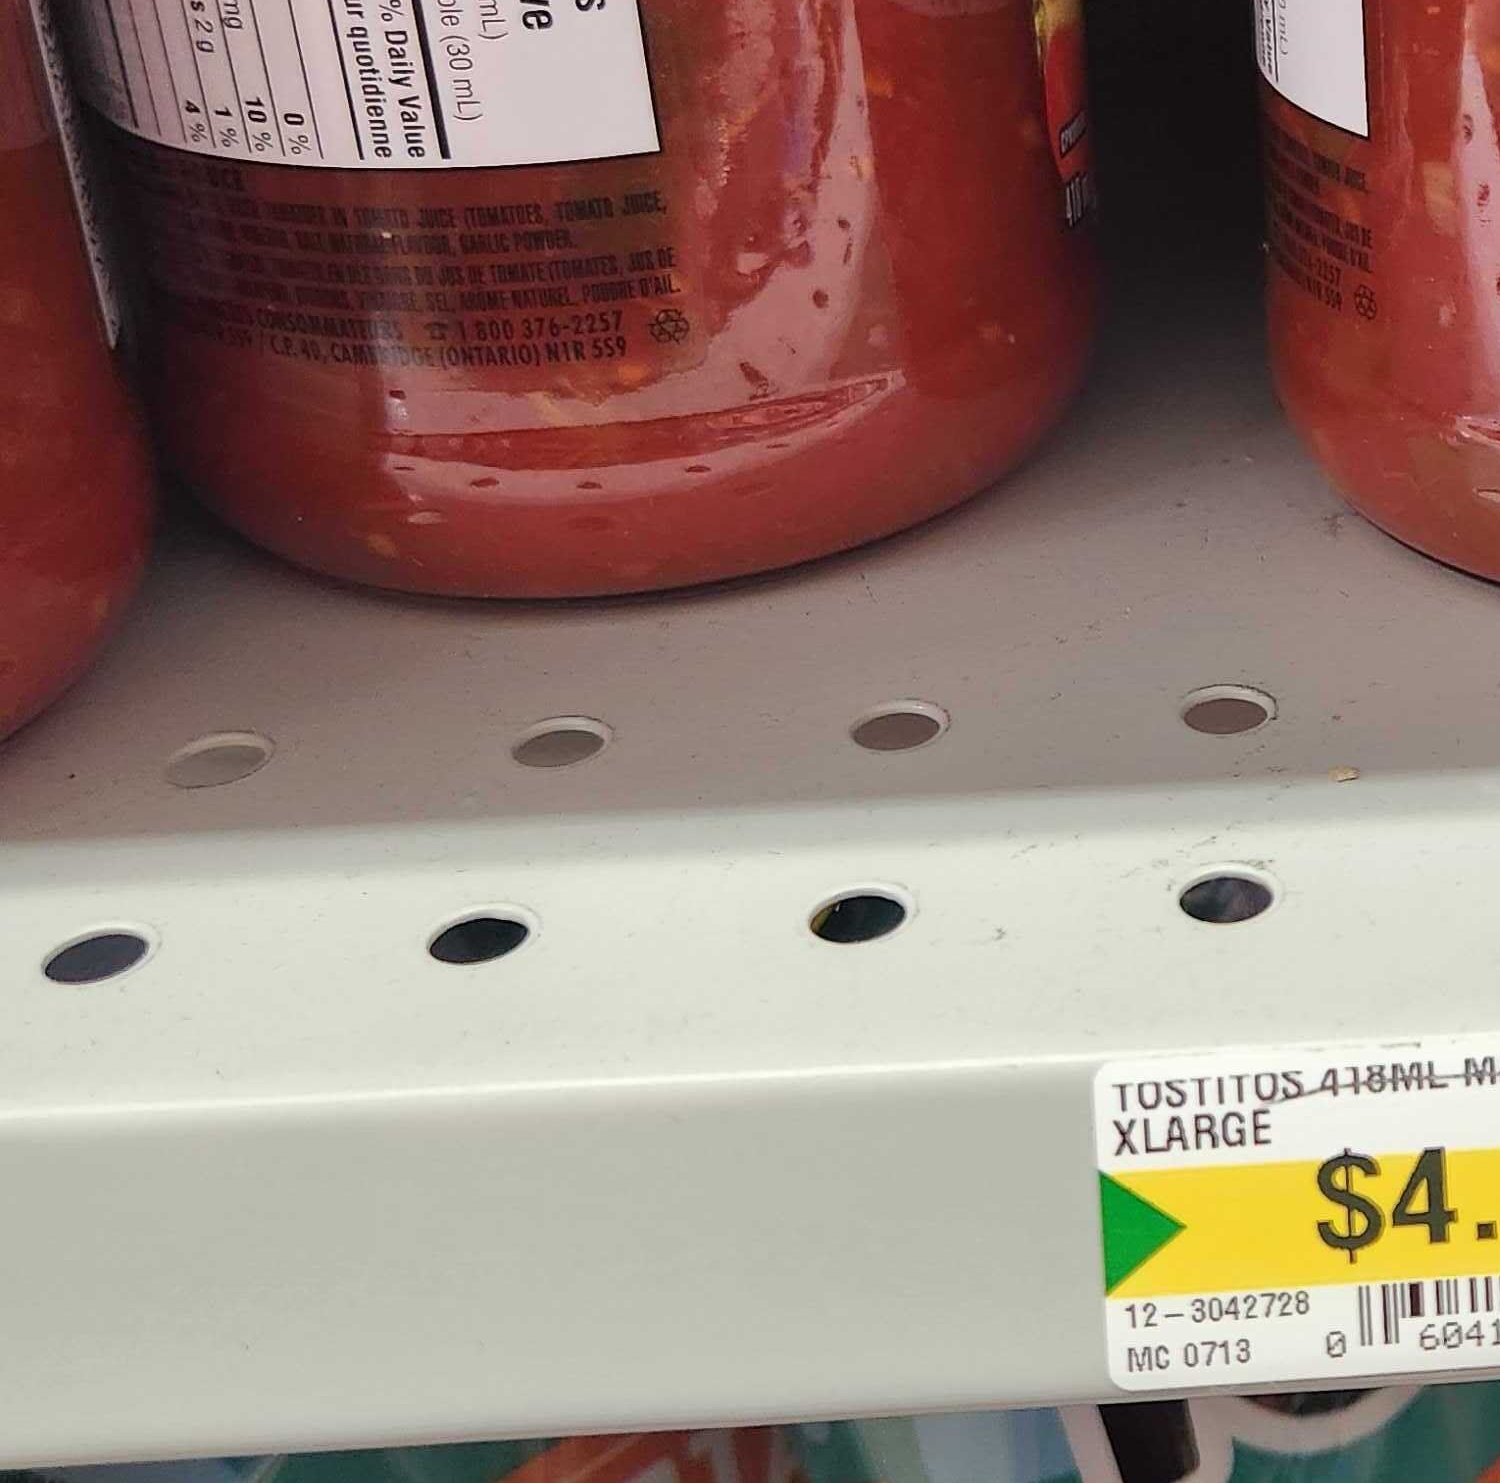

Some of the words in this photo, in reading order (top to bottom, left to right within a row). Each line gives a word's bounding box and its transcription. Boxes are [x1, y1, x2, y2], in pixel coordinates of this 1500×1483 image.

[194, 19, 214, 34] 2
[196, 40, 216, 54] g
[384, 29, 413, 88] Daily
[439, 34, 474, 72] (30
[185, 99, 202, 114] 4
[346, 26, 393, 159] quotidienne
[452, 79, 484, 122] mL)
[213, 106, 233, 118] 1
[244, 96, 268, 124] 10
[283, 112, 305, 126] 0
[189, 122, 209, 143] %
[221, 127, 240, 148] %
[398, 95, 426, 159] Value
[251, 131, 275, 152] %
[290, 134, 312, 155] %
[476, 318, 514, 342] 800
[522, 310, 624, 339] 376-2257
[438, 342, 543, 370] (ONTARIO)
[1111, 1070, 1304, 1114] TOSTITOS
[1319, 1060, 1448, 1100] 418ML
[1112, 1110, 1273, 1156] XLARGE
[1124, 1290, 1311, 1329] 12-3042728
[1127, 1345, 1177, 1374] MC
[1183, 1338, 1252, 1369] 0713
